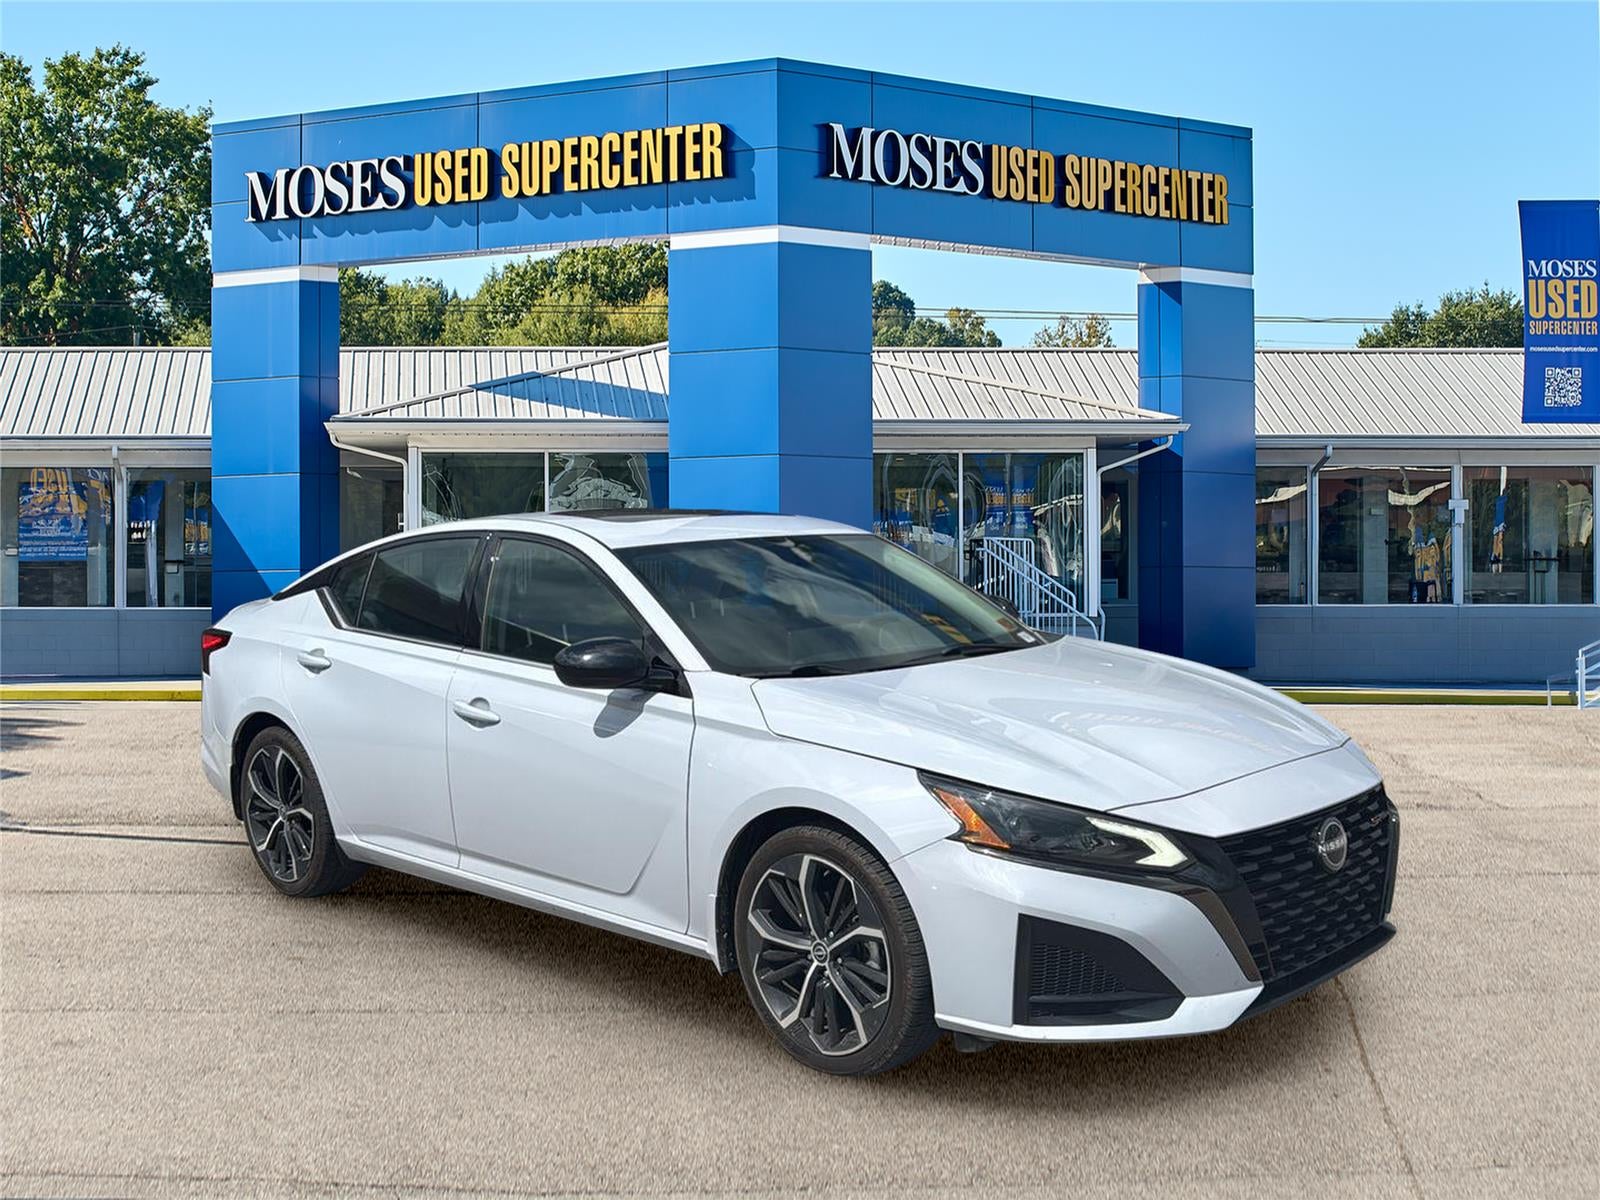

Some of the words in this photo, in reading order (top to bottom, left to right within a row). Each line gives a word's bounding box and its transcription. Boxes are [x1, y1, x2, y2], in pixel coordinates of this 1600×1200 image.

[245, 155, 406, 223] MOSES
[413, 147, 489, 206] USED
[501, 122, 725, 199] SUPERCENTER
[829, 122, 984, 196] MOSES
[991, 144, 1056, 204] USED
[1064, 154, 1230, 225] SUPERCENTER
[1528, 259, 1597, 277] MOSES
[1528, 279, 1598, 319] USED
[1529, 320, 1598, 335] SUPERCENTER
